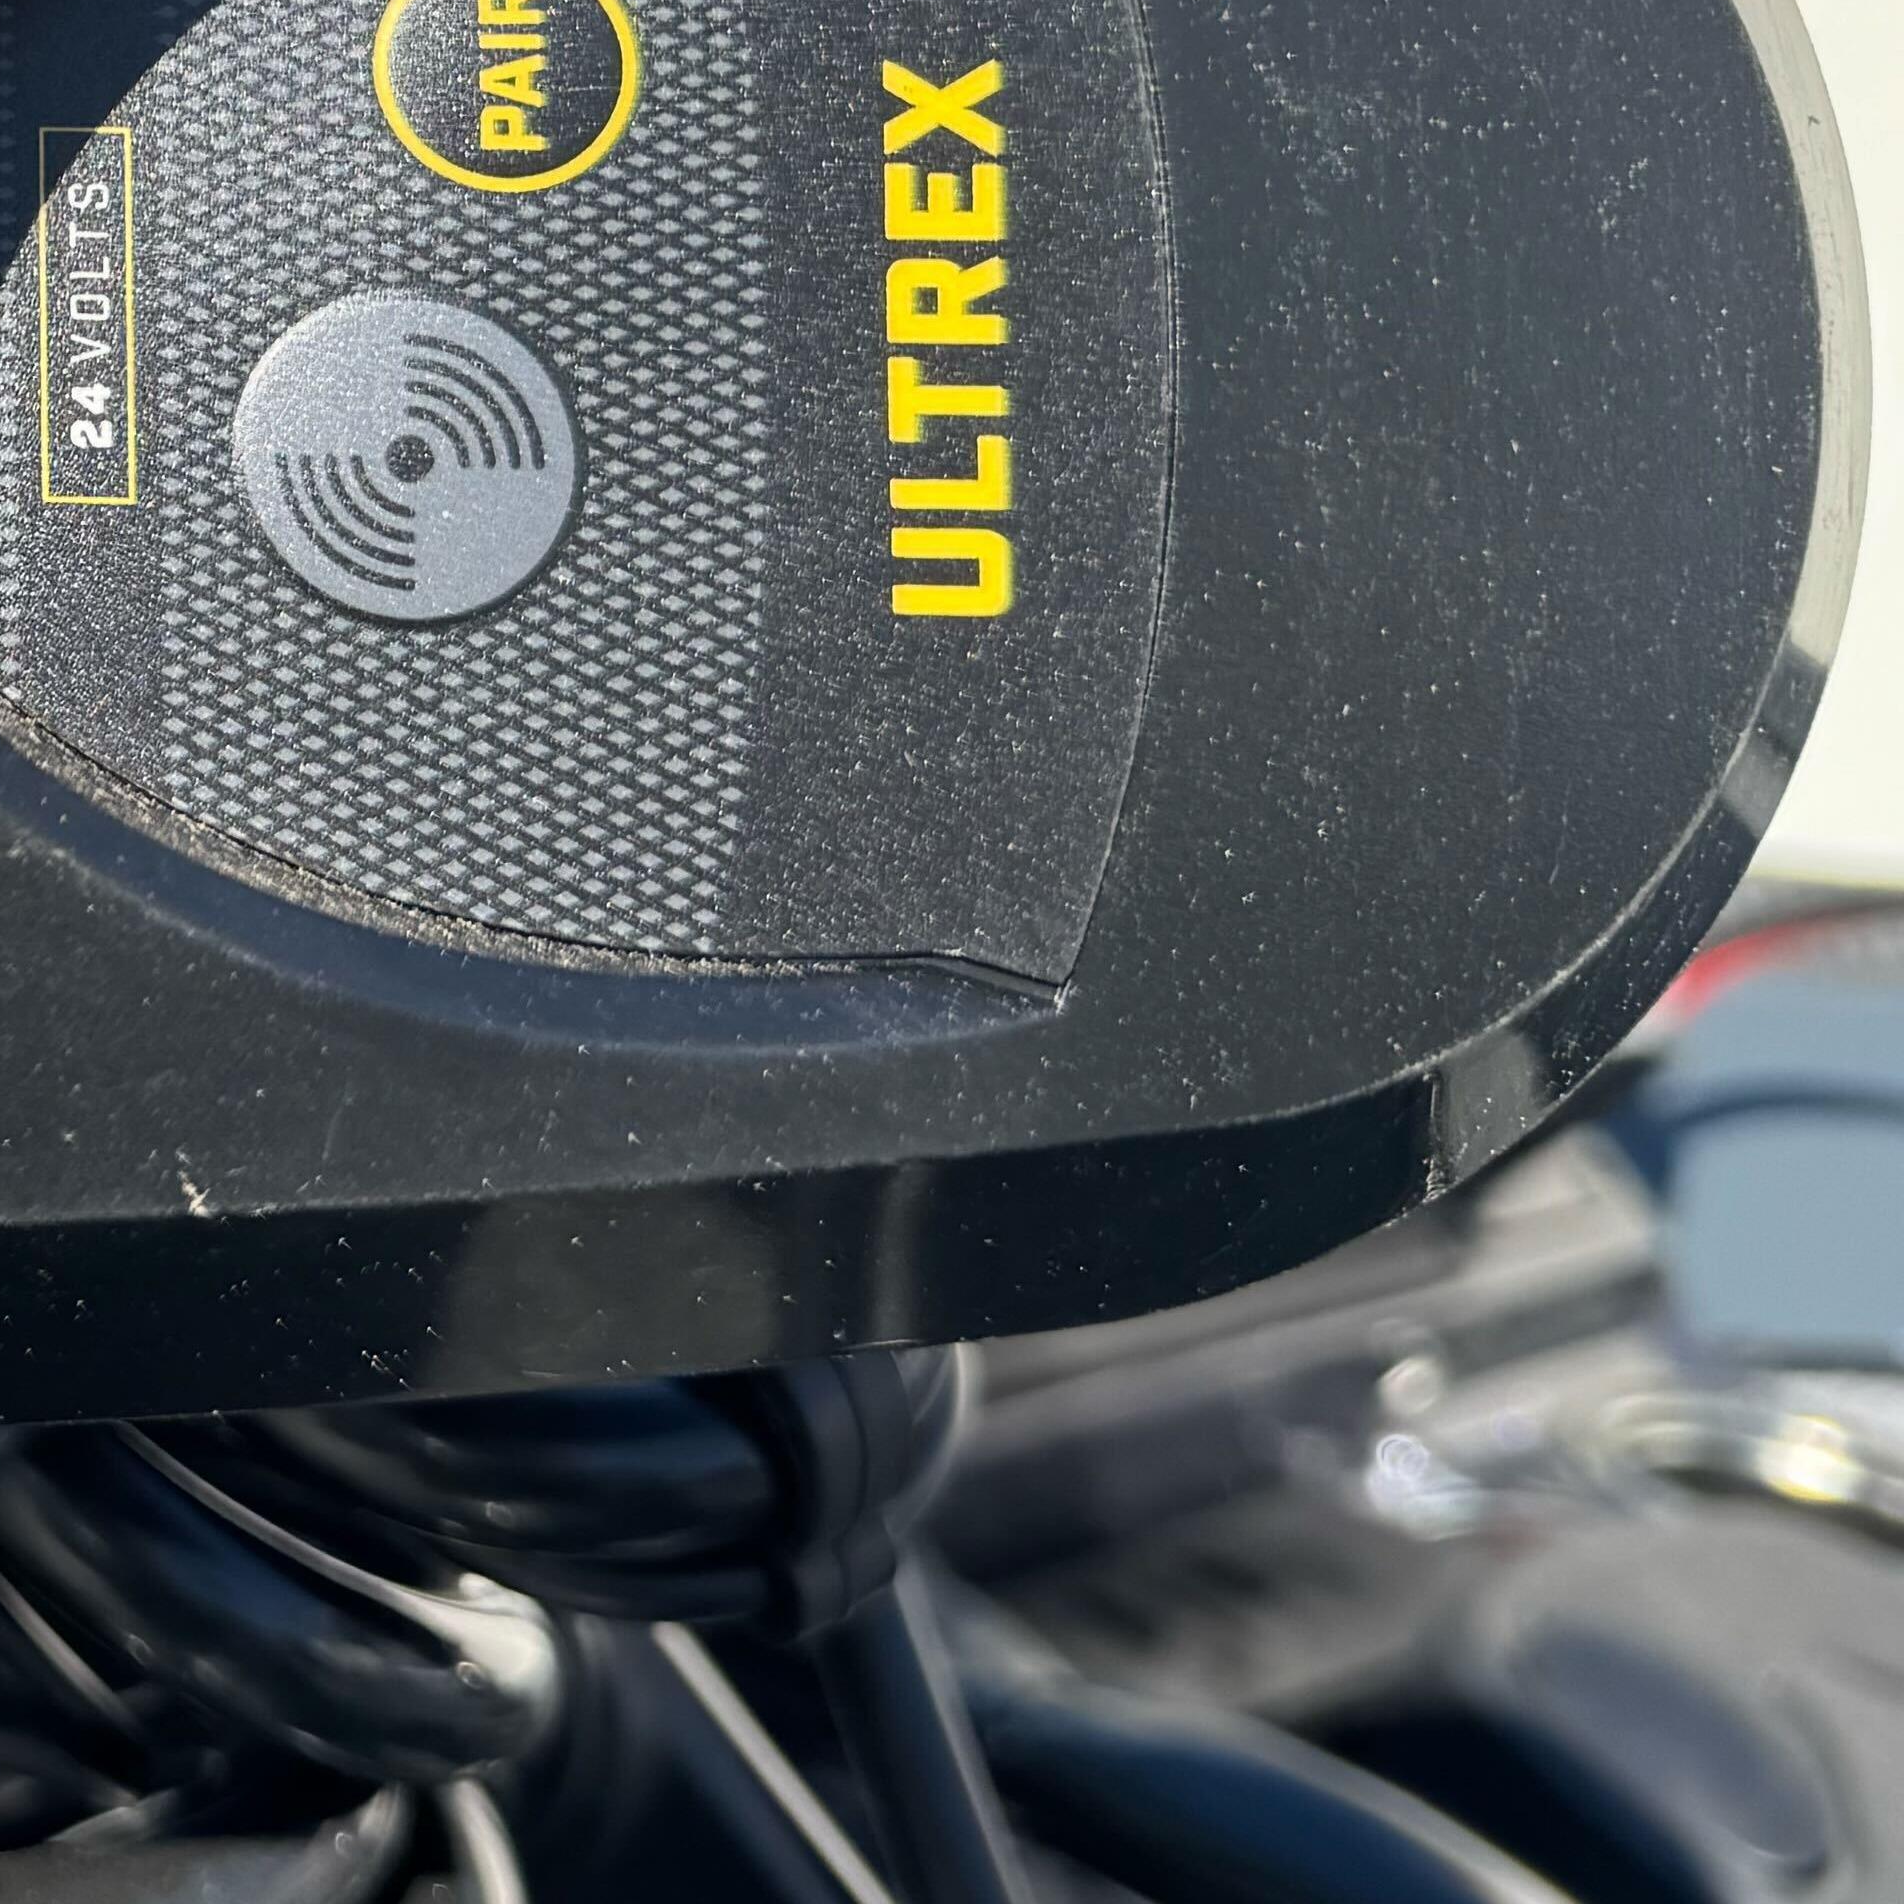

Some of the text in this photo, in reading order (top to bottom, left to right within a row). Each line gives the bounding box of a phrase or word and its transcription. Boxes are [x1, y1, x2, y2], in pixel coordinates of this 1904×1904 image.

[68, 182, 113, 450] 24 VOLTS
[882, 60, 1015, 618] ULTREX
